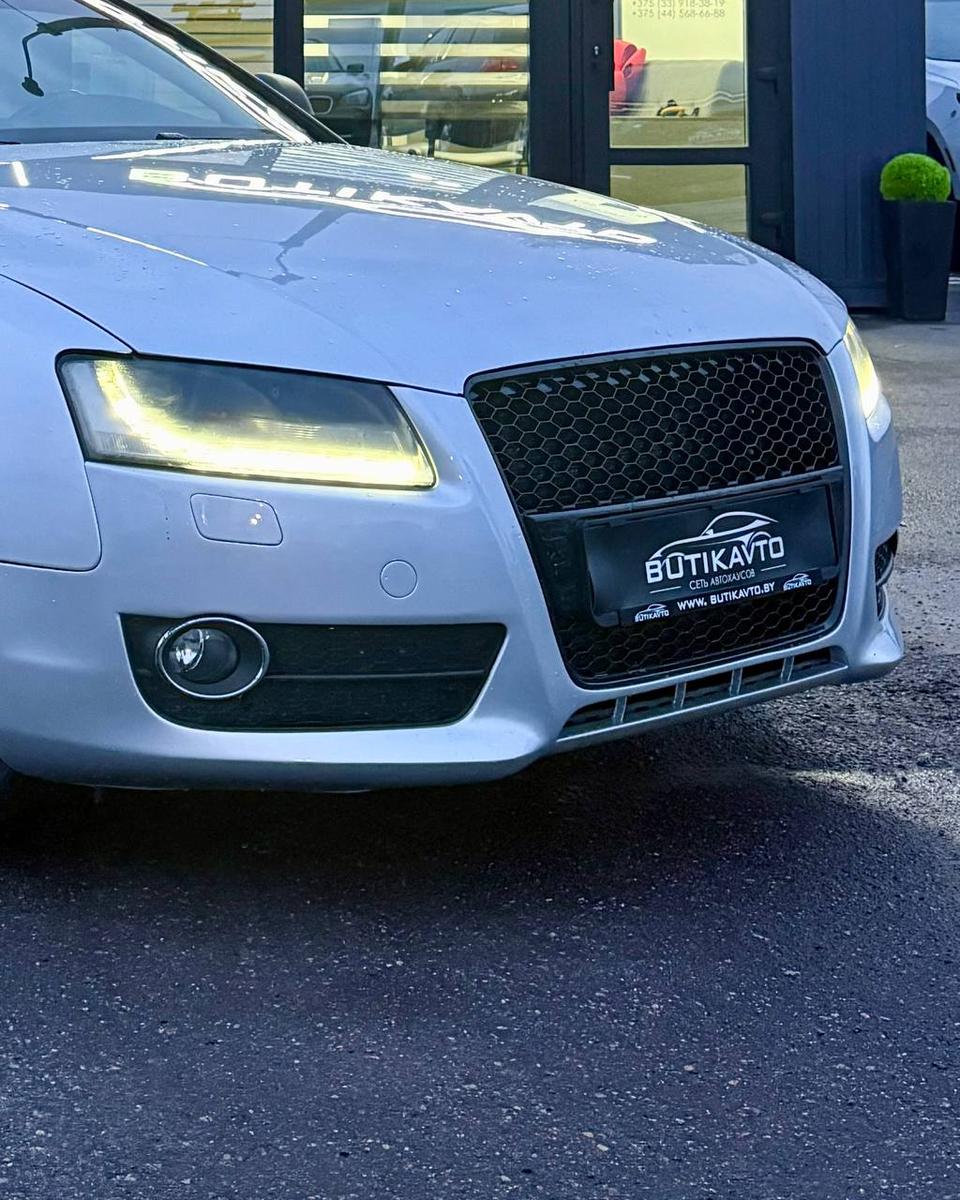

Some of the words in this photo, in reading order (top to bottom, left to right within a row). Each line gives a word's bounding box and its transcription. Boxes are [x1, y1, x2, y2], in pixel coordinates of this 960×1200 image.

[644, 535, 785, 584] BUTIKAVTO
[689, 578, 709, 591] СЕТЬ
[710, 568, 756, 588] АВТОХАУСОВ
[677, 597, 708, 611] WWW.
[710, 581, 776, 605] BUTIKAVTO.BY
